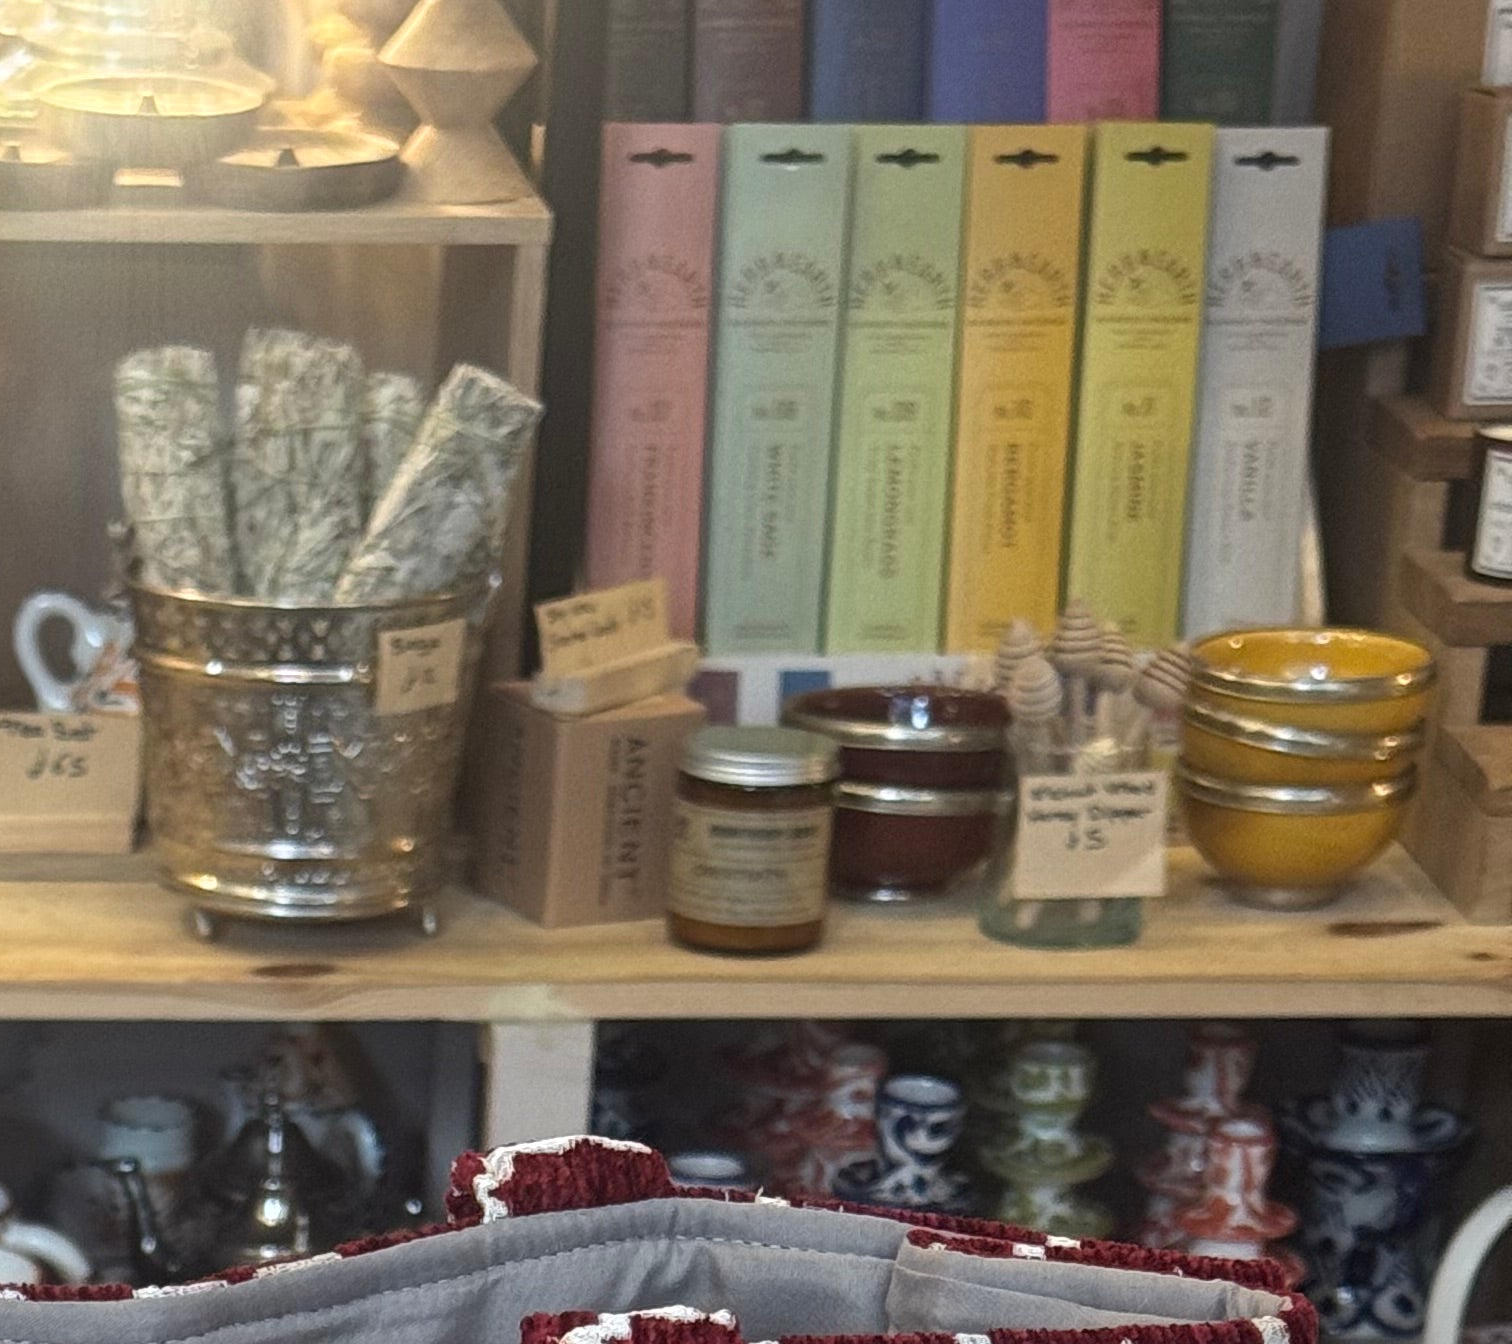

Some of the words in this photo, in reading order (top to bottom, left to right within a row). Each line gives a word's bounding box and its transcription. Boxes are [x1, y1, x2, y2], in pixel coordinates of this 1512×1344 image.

[879, 445, 904, 579] LEMONGRASS
[1240, 440, 1264, 521] VANILLA
[617, 735, 648, 880] ANCIENT
